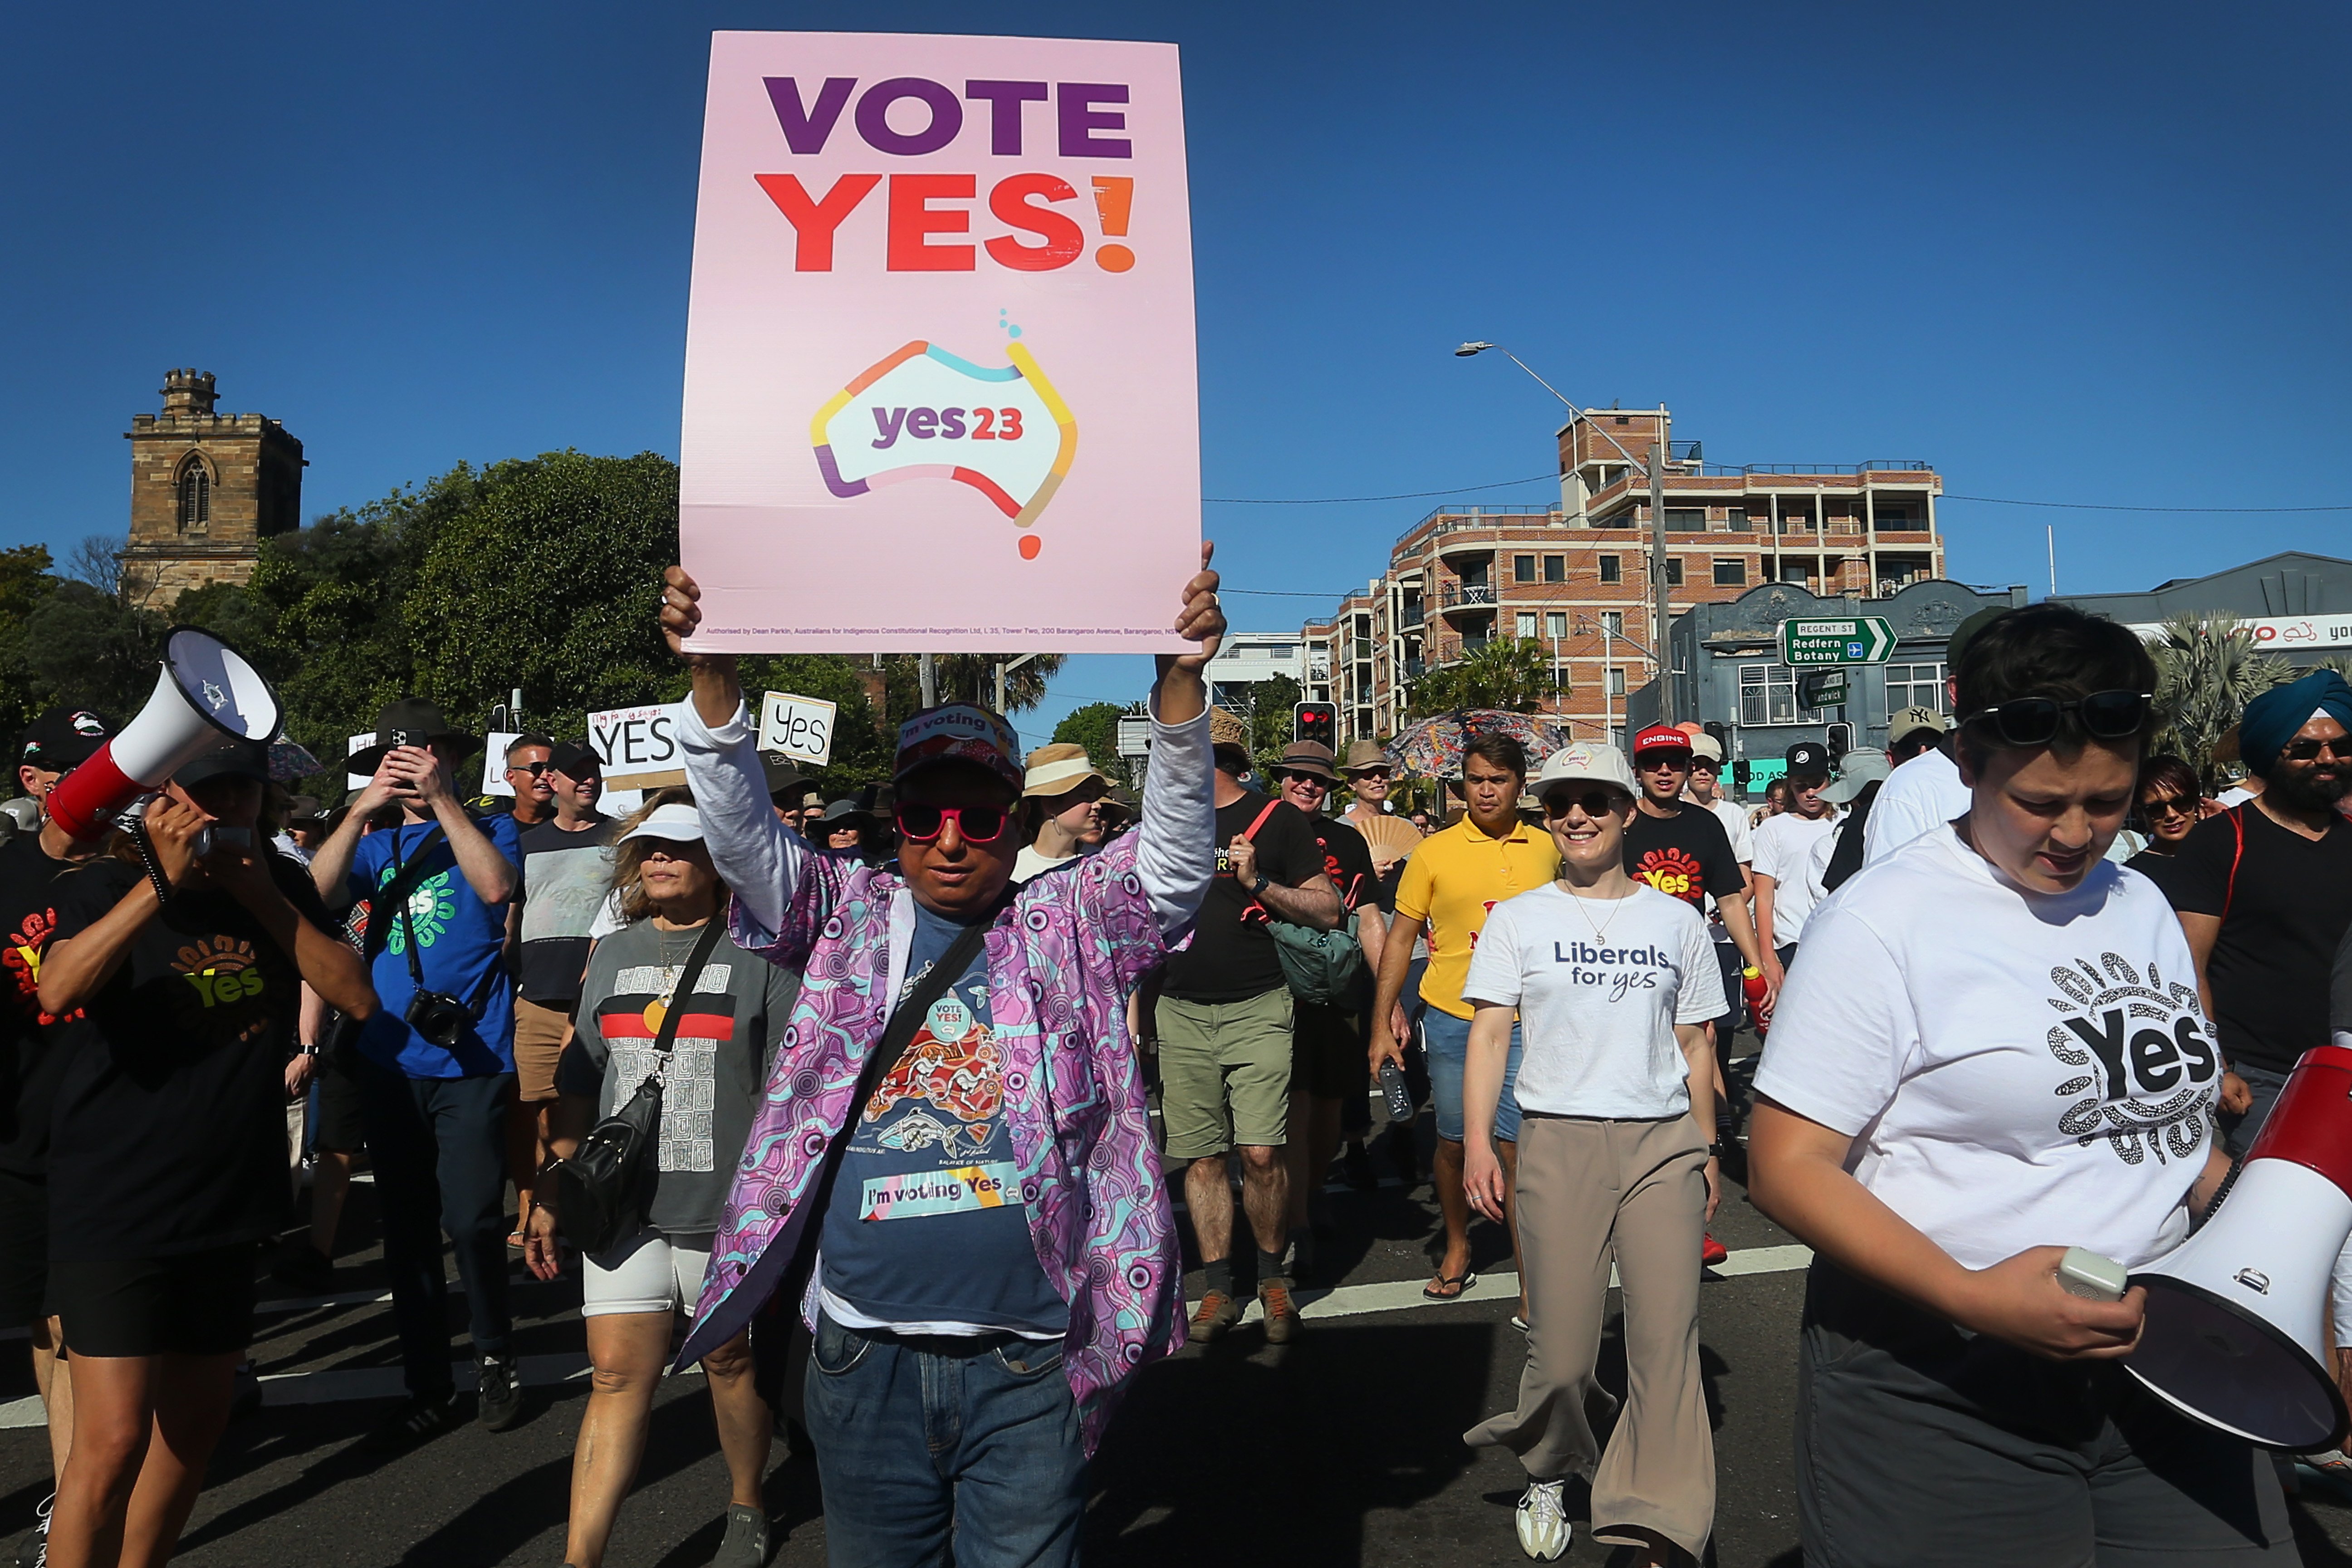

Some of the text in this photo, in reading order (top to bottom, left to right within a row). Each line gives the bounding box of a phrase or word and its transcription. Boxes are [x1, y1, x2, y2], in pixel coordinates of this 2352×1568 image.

[762, 76, 1132, 158] VOTE
[754, 173, 1136, 274] YES!
[1793, 638, 1841, 649] Redfern
[2330, 627, 2352, 641] yo
[1794, 651, 1840, 662] Botany
[593, 714, 607, 728] My
[773, 704, 825, 754] yes
[923, 712, 986, 731] voting
[989, 720, 1014, 749] Yes
[593, 717, 675, 766] YES
[1642, 869, 1690, 893] Yes
[1554, 941, 1669, 969] Liberals
[183, 967, 264, 1008] Yes
[1571, 966, 1658, 1003] for yes
[936, 1013, 962, 1023] YES!
[2061, 1008, 2215, 1100] Yes
[867, 1176, 1002, 1206] I'm voting Yes
